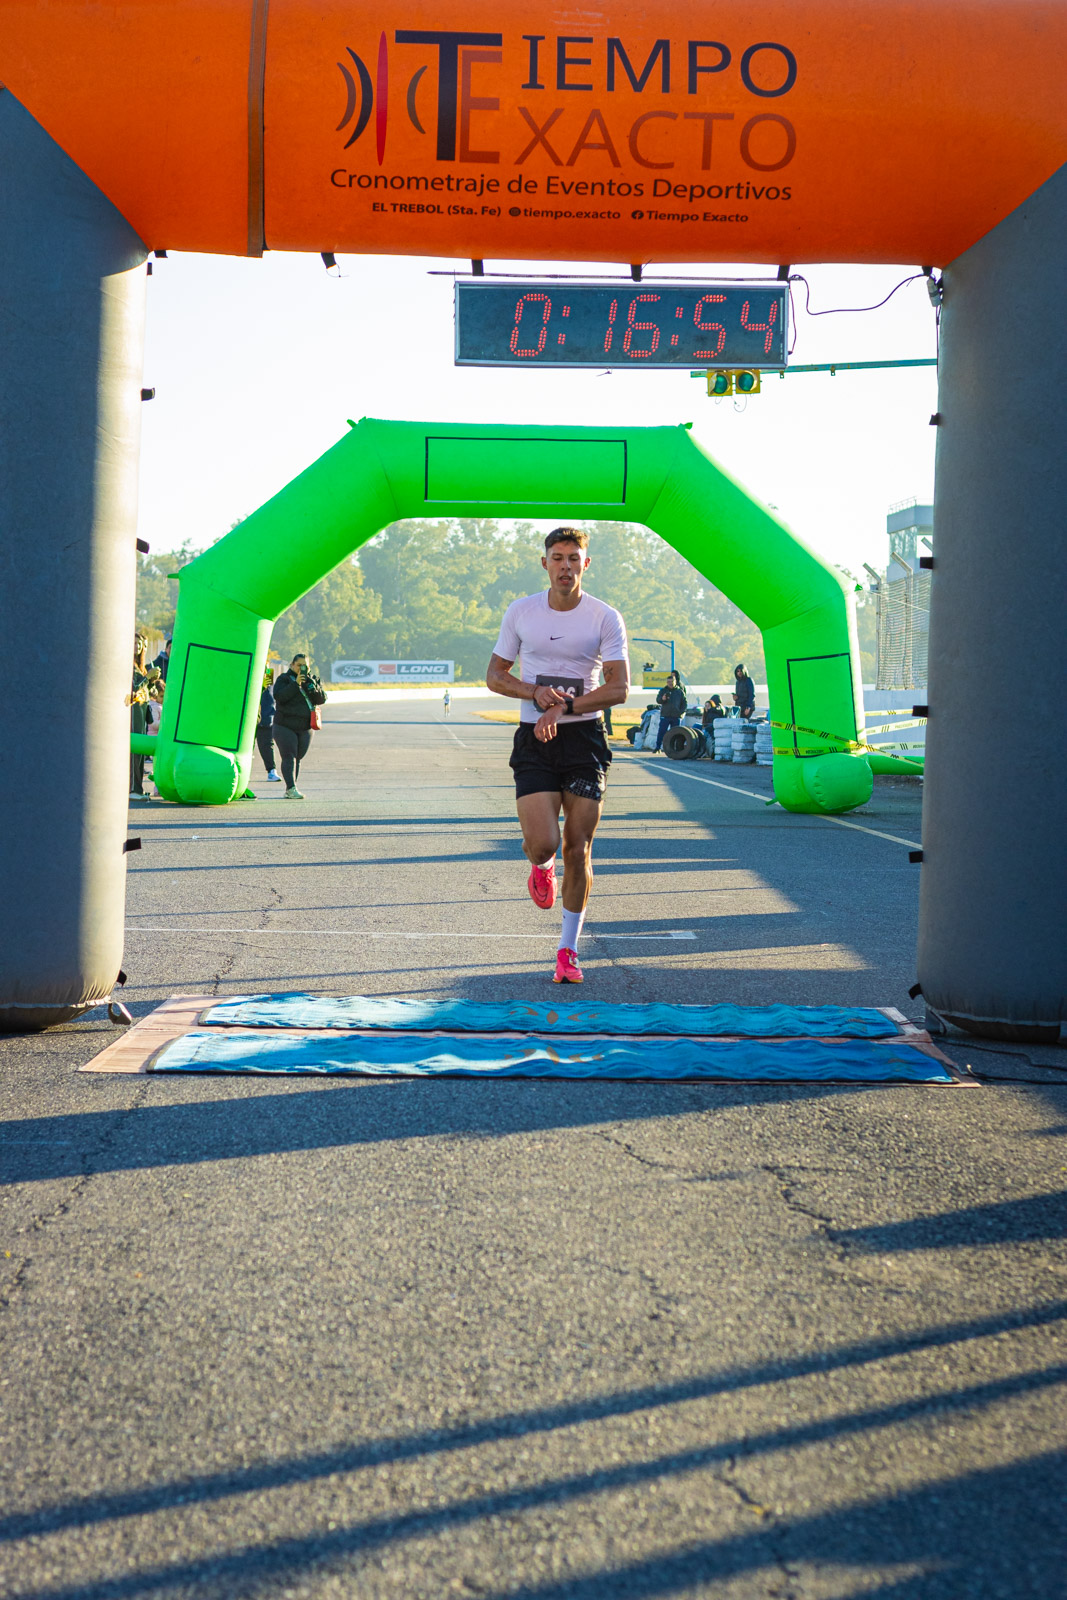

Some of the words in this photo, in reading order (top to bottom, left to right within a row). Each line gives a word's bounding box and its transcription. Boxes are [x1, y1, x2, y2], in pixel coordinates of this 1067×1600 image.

[330, 169, 500, 196] Cronometraje
[507, 174, 538, 194] de
[546, 176, 645, 197] Eventos
[652, 178, 792, 203] Deportivos
[372, 202, 388, 212] EL
[390, 203, 444, 214] TREBOL
[447, 205, 478, 216] (Sta.
[481, 206, 502, 217] Fe)
[523, 206, 621, 220] tiempo.exacto
[647, 210, 699, 222] Tiempo
[702, 212, 749, 222] Exacto
[342, 665, 366, 676] Ford
[400, 665, 446, 673] LONG
